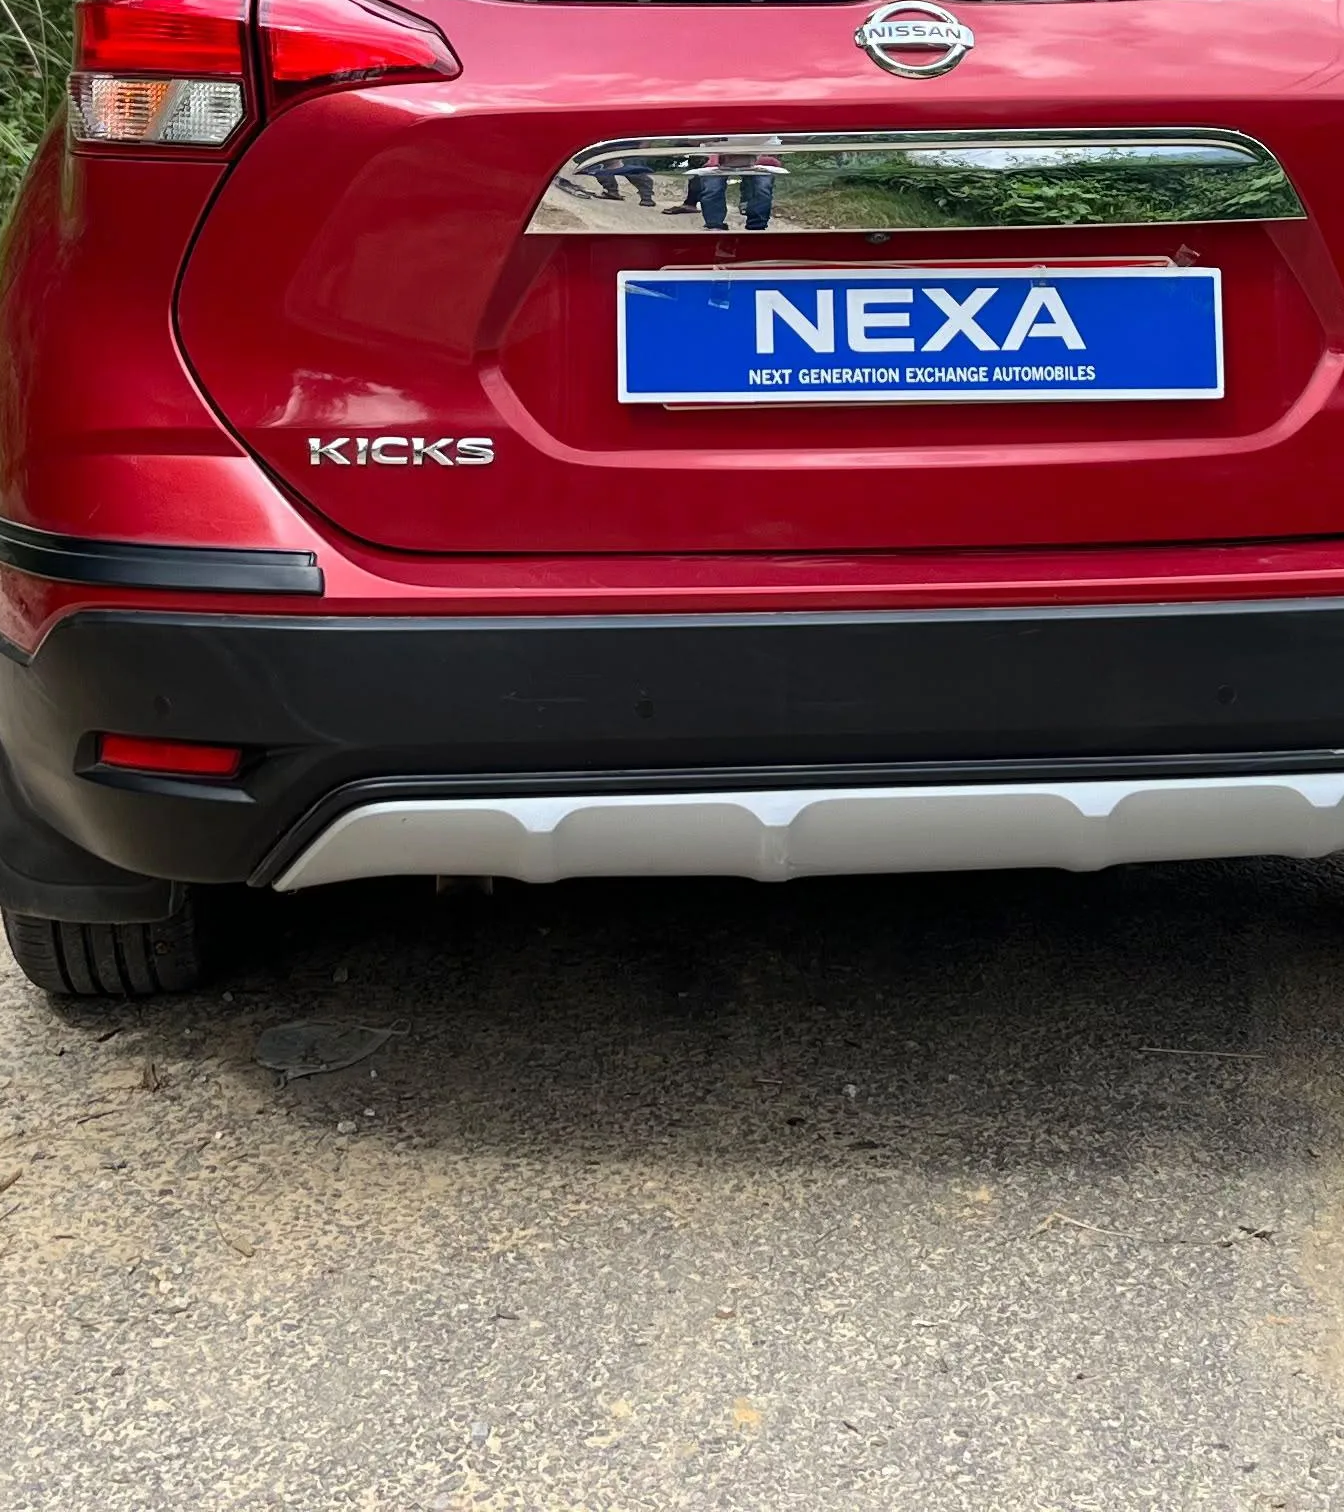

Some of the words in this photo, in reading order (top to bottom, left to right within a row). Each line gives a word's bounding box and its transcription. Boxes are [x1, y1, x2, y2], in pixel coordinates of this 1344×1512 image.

[868, 25, 961, 40] NISSAN
[755, 287, 1087, 355] NEXA
[748, 368, 791, 385] NEXT
[798, 366, 900, 385] GENERATION
[905, 365, 990, 384] EXCHANGE
[992, 364, 1096, 383] AUTOMOBILES
[307, 435, 495, 467] KICKS
